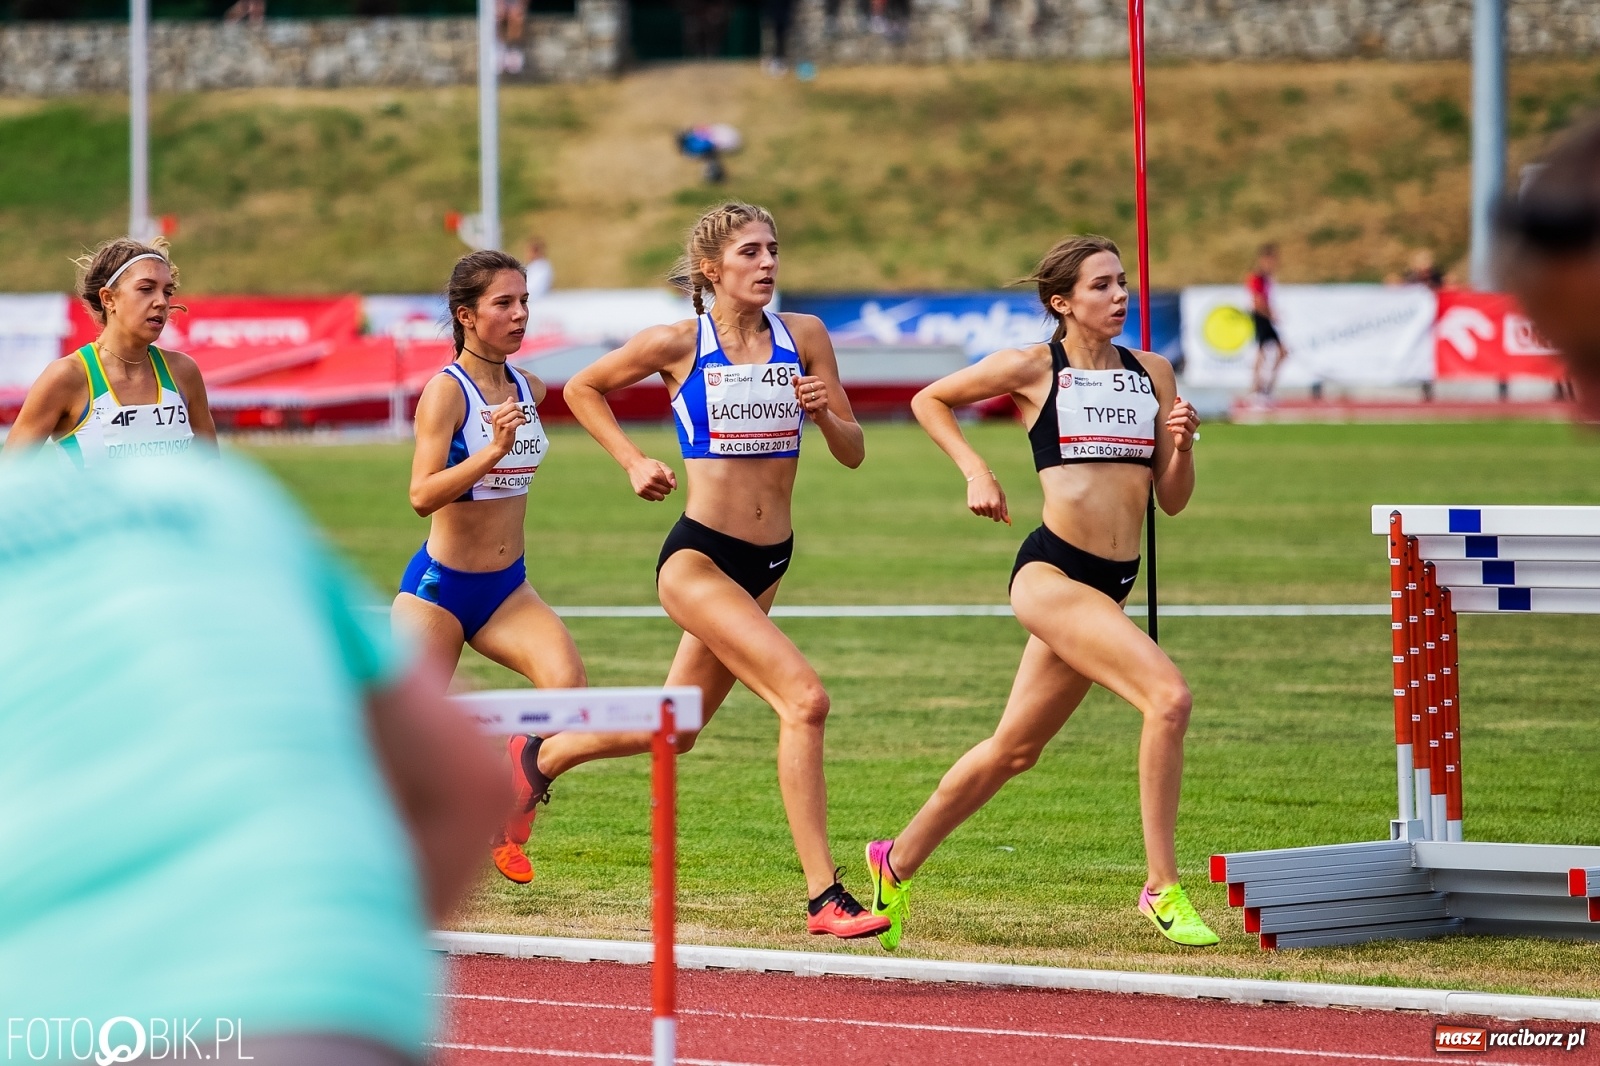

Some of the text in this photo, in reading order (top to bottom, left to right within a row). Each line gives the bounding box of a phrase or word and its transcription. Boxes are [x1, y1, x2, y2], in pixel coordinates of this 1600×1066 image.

[1113, 373, 1151, 394] 518
[153, 405, 187, 425] 175
[522, 405, 539, 424] 59
[711, 403, 799, 419] ŁACHOWSKA
[1083, 406, 1137, 425] TYPER
[720, 440, 791, 452] RACIBÓRZ 2019
[1073, 444, 1144, 457] RACIBÓRZ 2019
